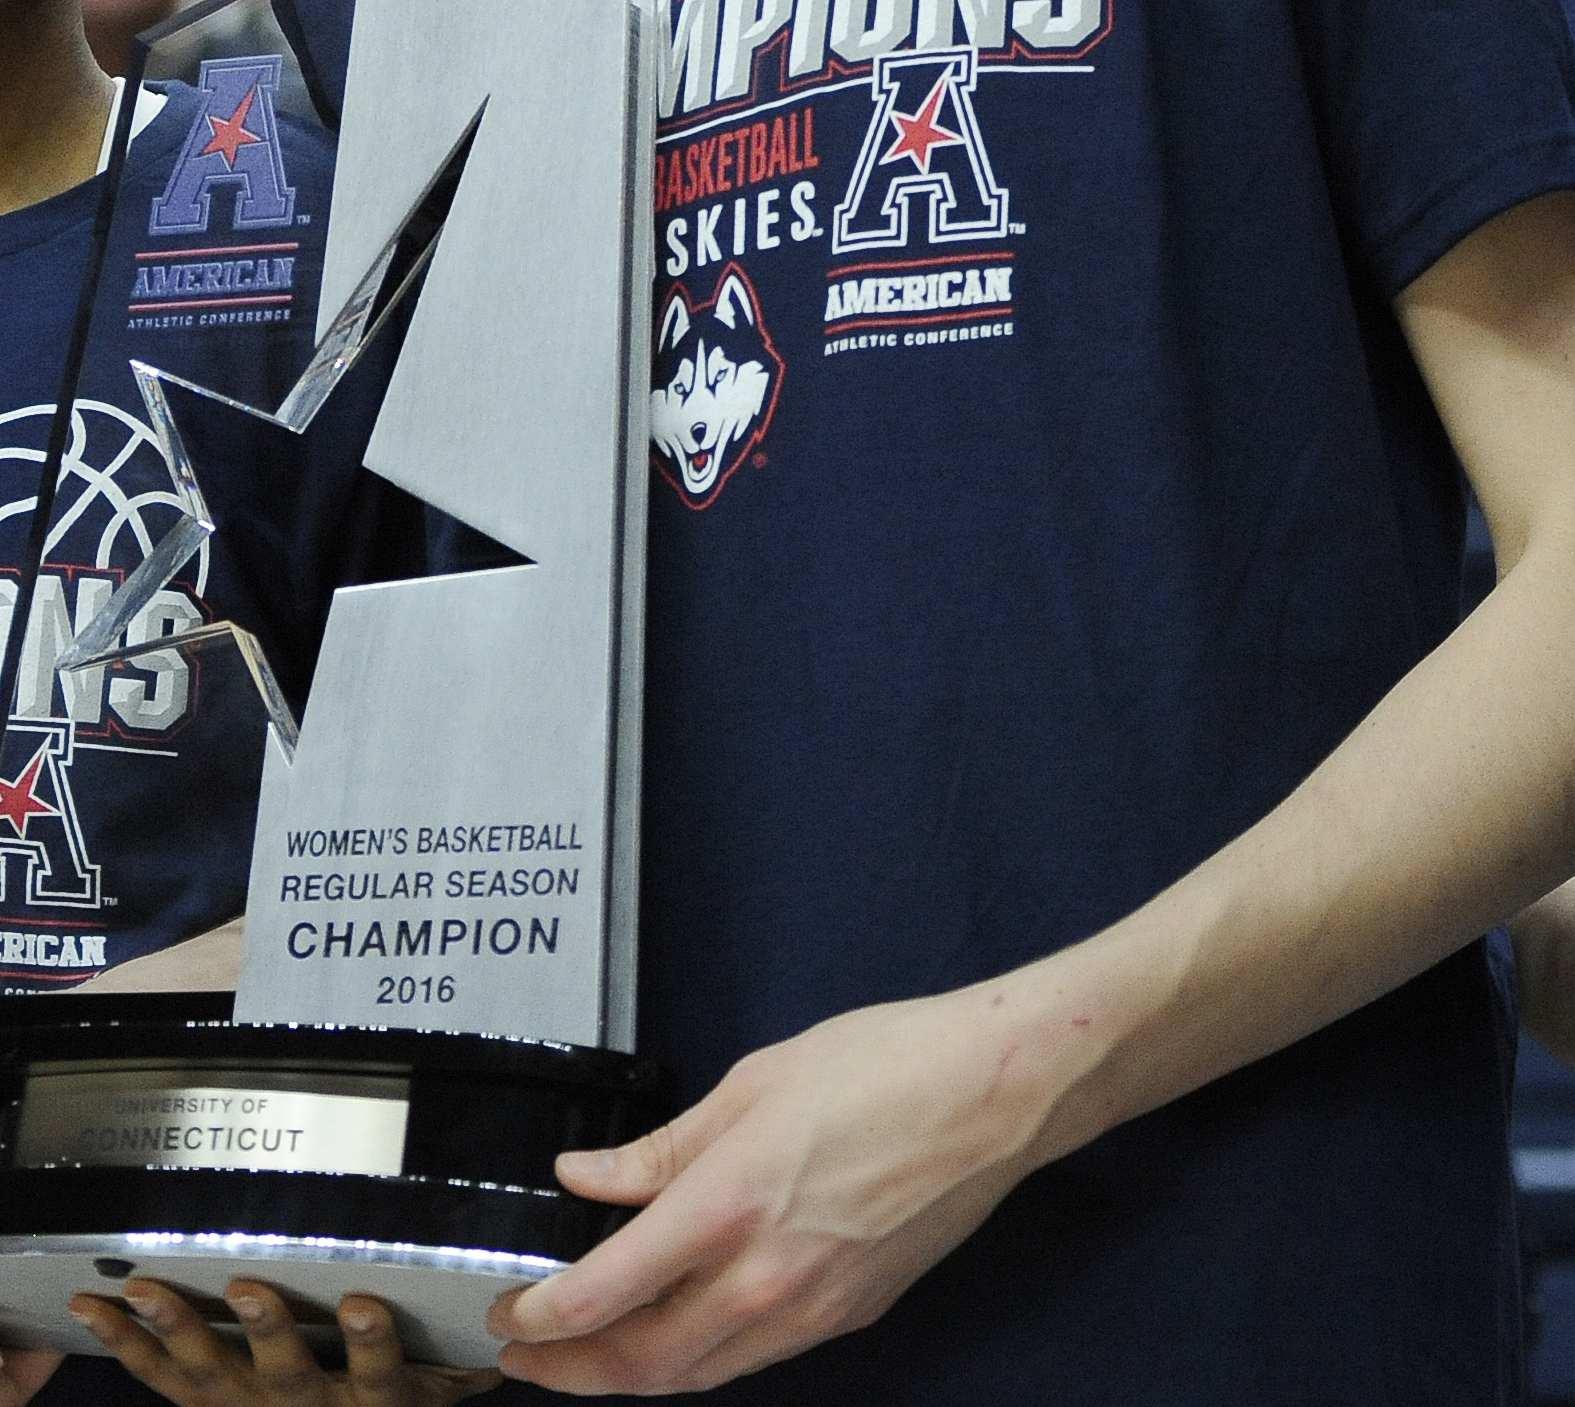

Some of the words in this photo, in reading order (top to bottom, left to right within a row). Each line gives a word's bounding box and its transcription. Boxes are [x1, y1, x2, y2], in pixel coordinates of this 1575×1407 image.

[654, 107, 819, 212] BASKETBALL
[666, 180, 817, 277] SKIES
[130, 257, 295, 298] AMERICAN
[824, 267, 1013, 322] AMERICAN
[127, 314, 193, 329] ATHLETIC
[199, 309, 291, 326] CONFERENCE
[824, 333, 897, 356] ATHLETIC
[903, 322, 1014, 347] CONFERENCE
[287, 827, 409, 858] WOMEN'S
[417, 823, 582, 855] BASKETBALL
[280, 872, 434, 903] REGULAR
[445, 868, 580, 898] SEASON
[287, 917, 560, 959] CHAMPION
[376, 975, 456, 1005] 2016
[112, 1097, 232, 1115] UNIVERSITY
[241, 1098, 269, 1114] OF
[78, 1126, 304, 1153] CONNECTICUT
